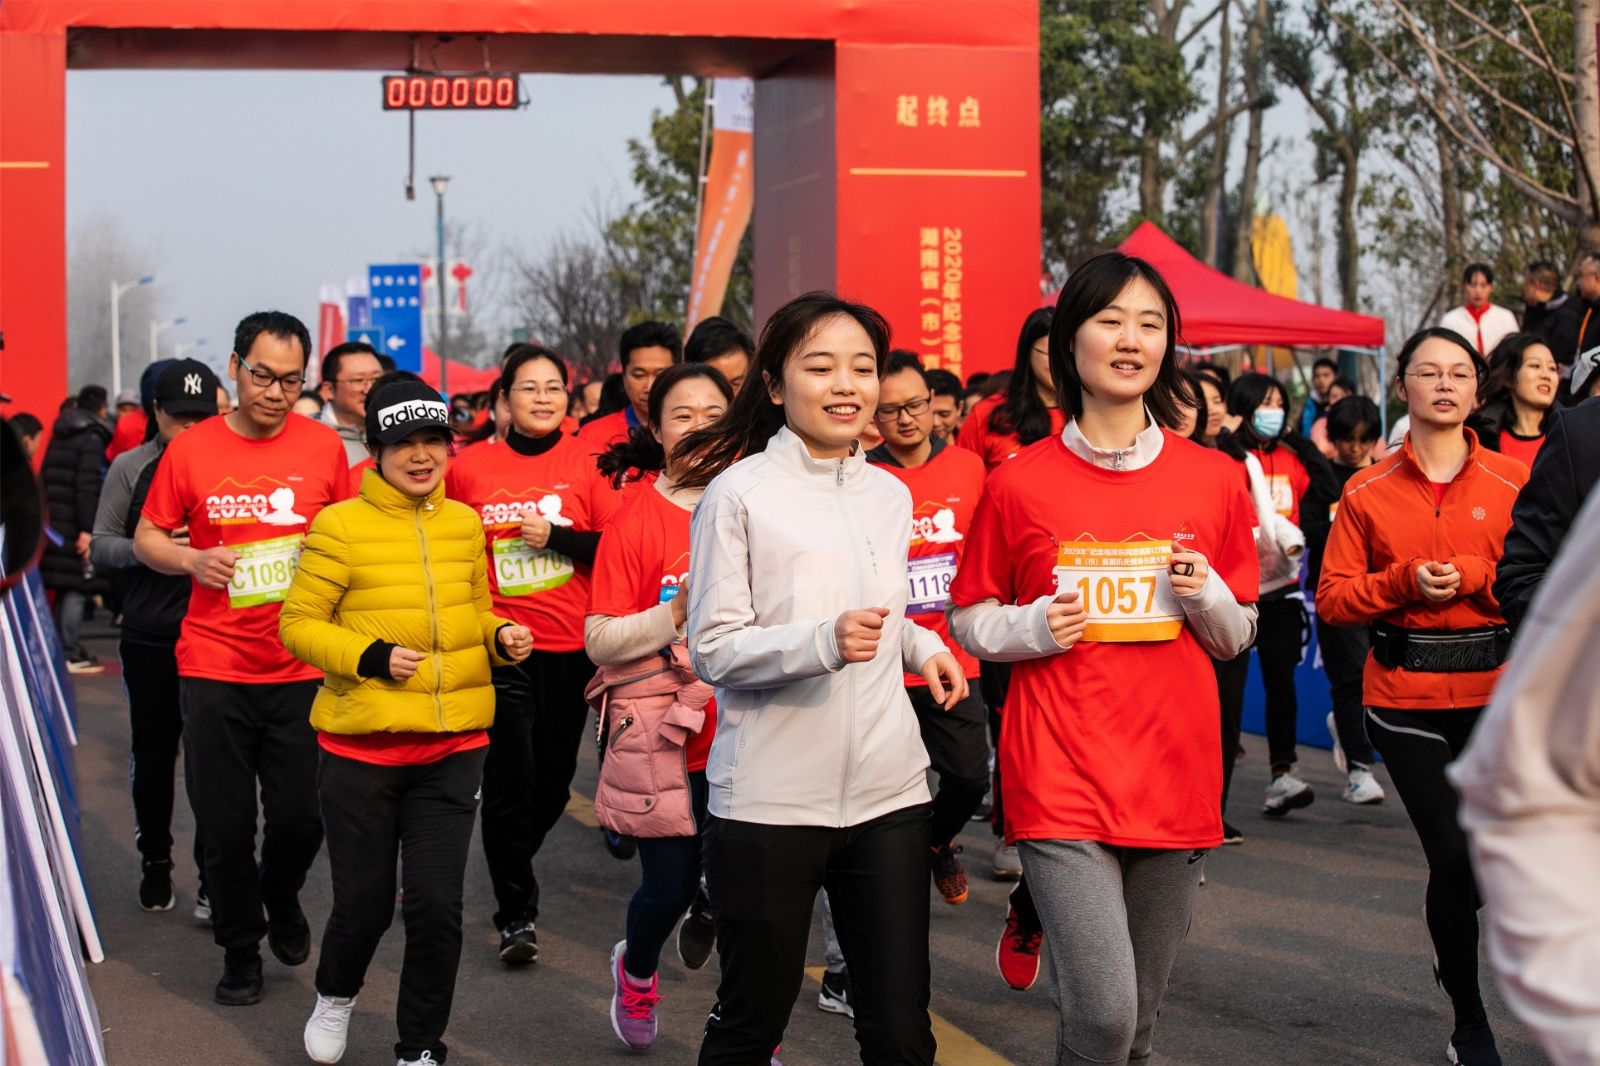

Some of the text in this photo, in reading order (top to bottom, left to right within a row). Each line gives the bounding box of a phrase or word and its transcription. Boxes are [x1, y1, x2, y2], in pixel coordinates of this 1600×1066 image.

[896, 94, 981, 128] 起终点
[184, 373, 202, 395] NY
[383, 404, 447, 428] adidas
[1076, 575, 1157, 615] 1057
